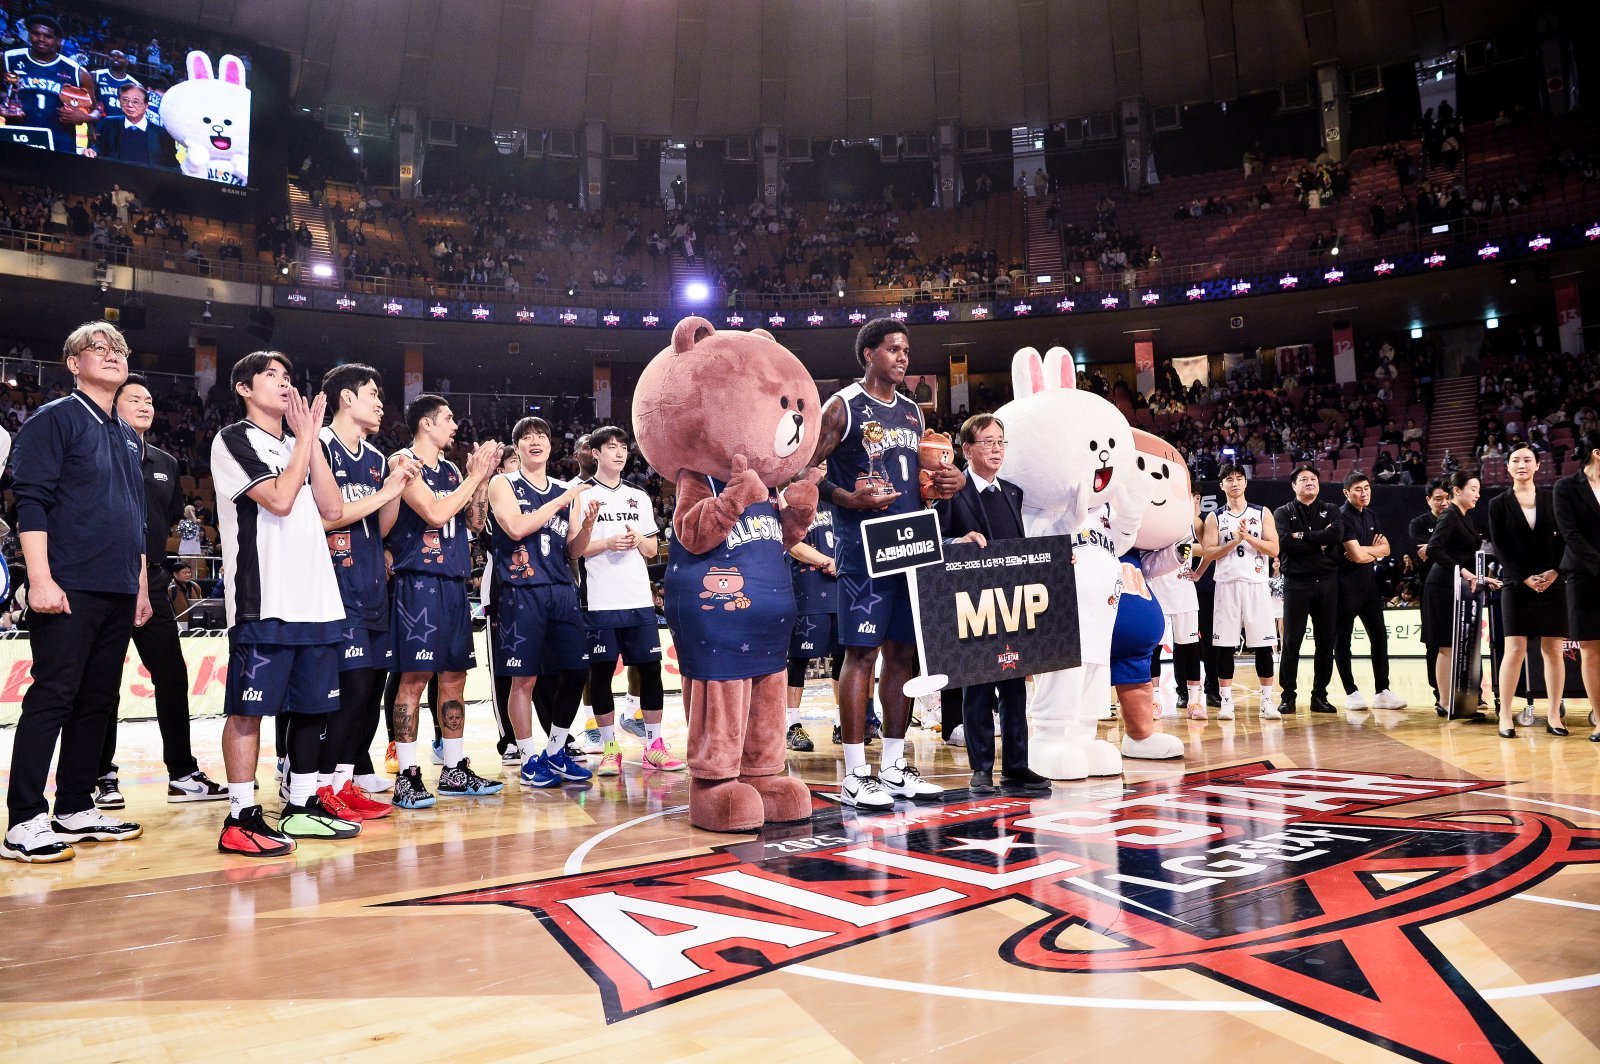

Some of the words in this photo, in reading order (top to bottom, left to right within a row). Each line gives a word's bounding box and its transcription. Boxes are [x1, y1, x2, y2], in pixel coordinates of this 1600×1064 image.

[13, 133, 29, 143] LG
[1335, 341, 1351, 354] 12
[1137, 360, 1152, 372] 12
[896, 427, 919, 452] STA
[898, 454, 909, 481] 1
[597, 513, 614, 523] ALL
[616, 512, 640, 522] STAR
[725, 514, 759, 549] ALL
[896, 526, 914, 542] LG
[540, 533, 551, 557] 5
[875, 539, 935, 563] 스탠바이미2
[1236, 545, 1244, 557] 6
[945, 560, 981, 571] 2025-2026
[955, 583, 1050, 640] MVP
[858, 621, 877, 634] KBL
[344, 645, 364, 659] KBL
[415, 649, 434, 661] KBL
[506, 657, 523, 668] KBL
[241, 687, 263, 702] KBL
[1010, 768, 1482, 847] STAR
[763, 834, 854, 853] 2025
[555, 846, 1084, 990] ALL
